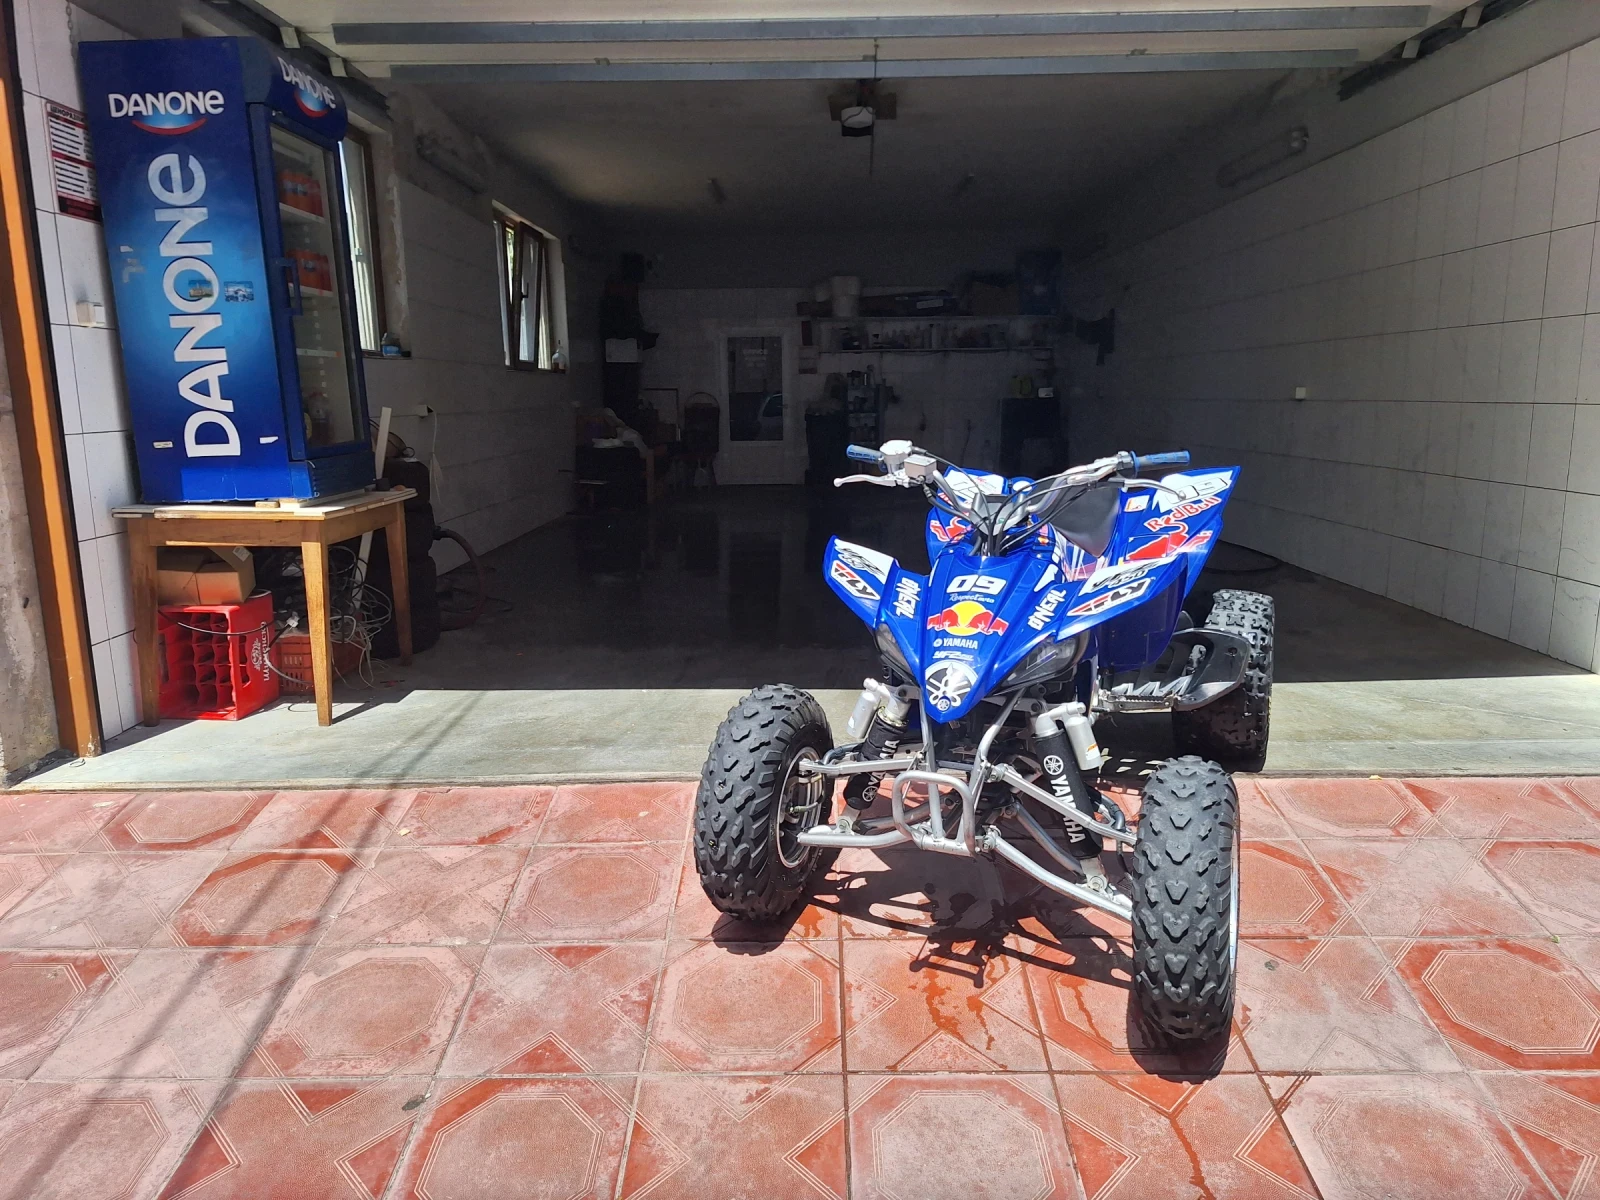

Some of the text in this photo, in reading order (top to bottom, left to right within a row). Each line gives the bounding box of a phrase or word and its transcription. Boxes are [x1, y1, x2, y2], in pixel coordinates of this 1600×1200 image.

[1182, 496, 1221, 516] Bull
[946, 575, 1006, 595] 09
[943, 638, 978, 650] YAMAHA
